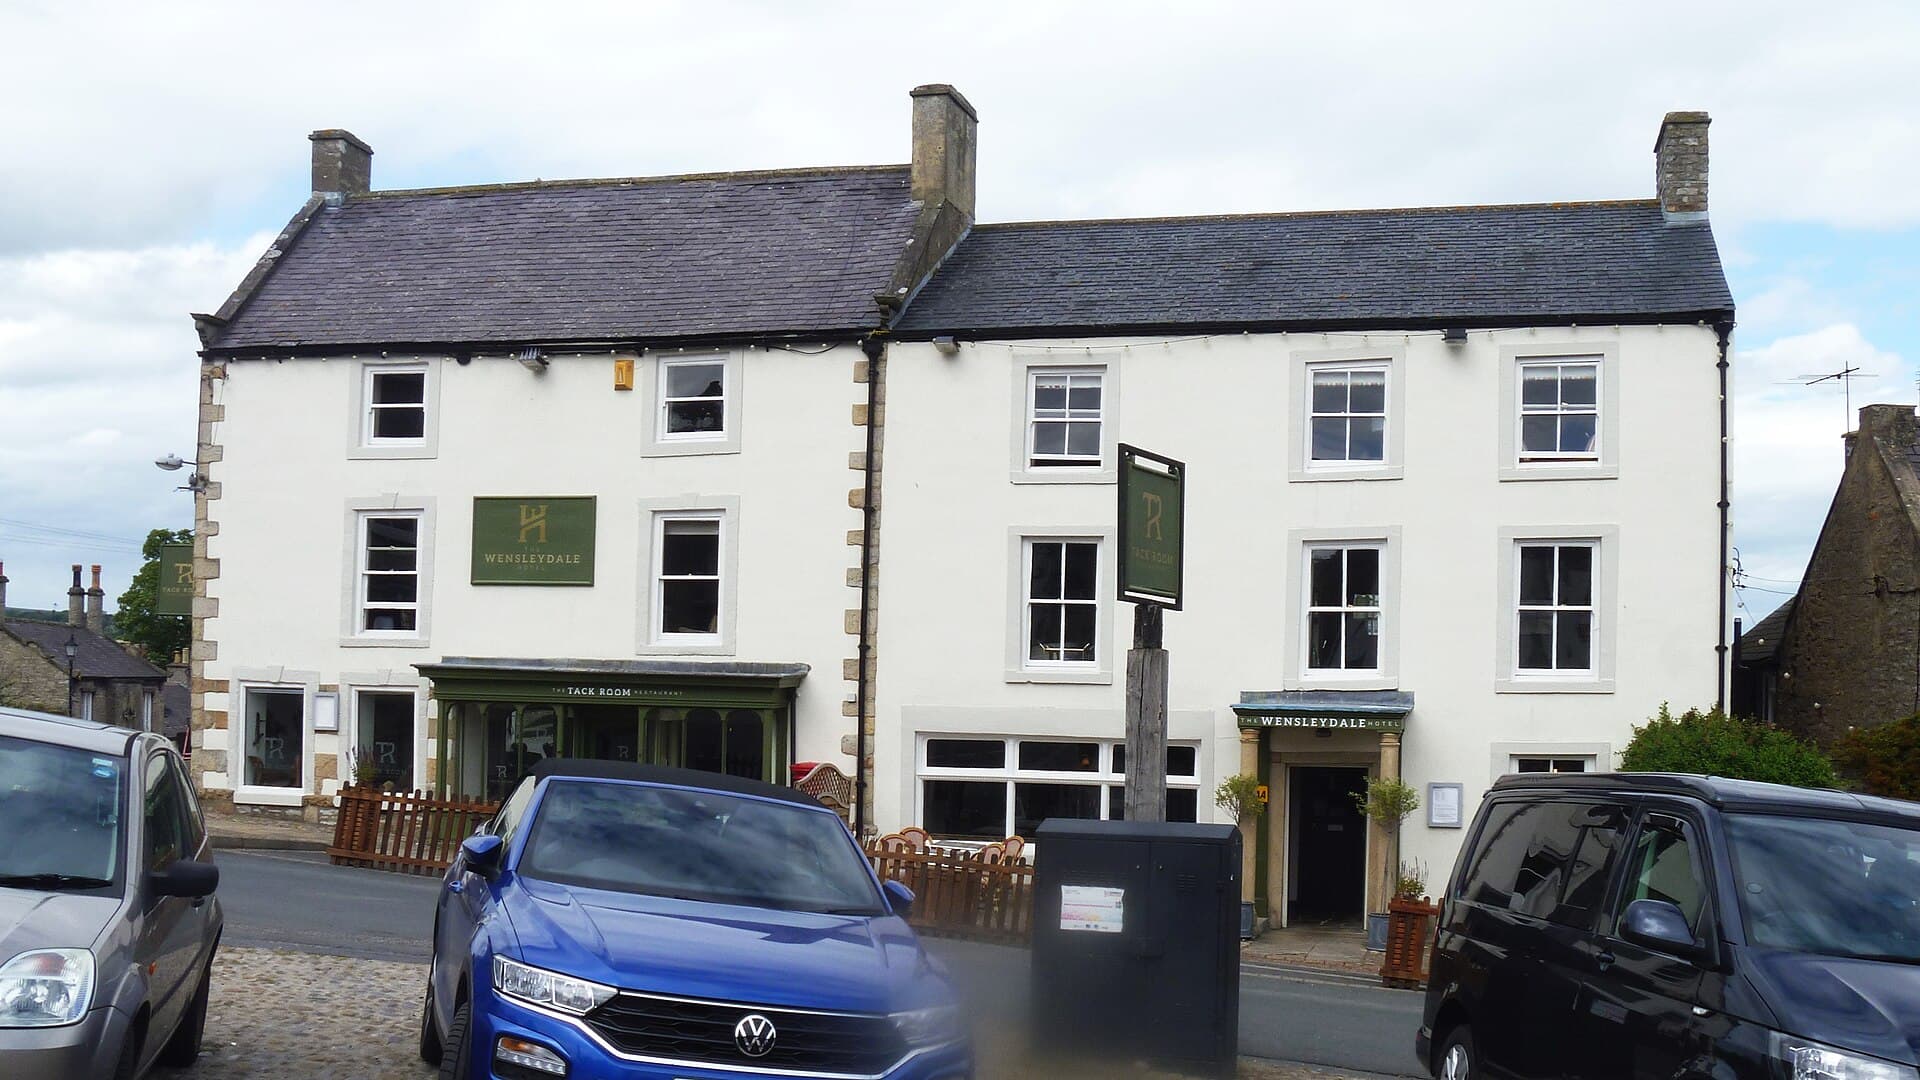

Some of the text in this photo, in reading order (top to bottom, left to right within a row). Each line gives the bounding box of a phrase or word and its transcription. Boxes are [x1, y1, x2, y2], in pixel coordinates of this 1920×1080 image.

[484, 553, 581, 564] WENSLEYDALE
[567, 686, 595, 696] TACK
[599, 687, 631, 697] ROOM
[1260, 715, 1367, 729] WENSLEYDALE
[1367, 720, 1400, 728] HOTEL
